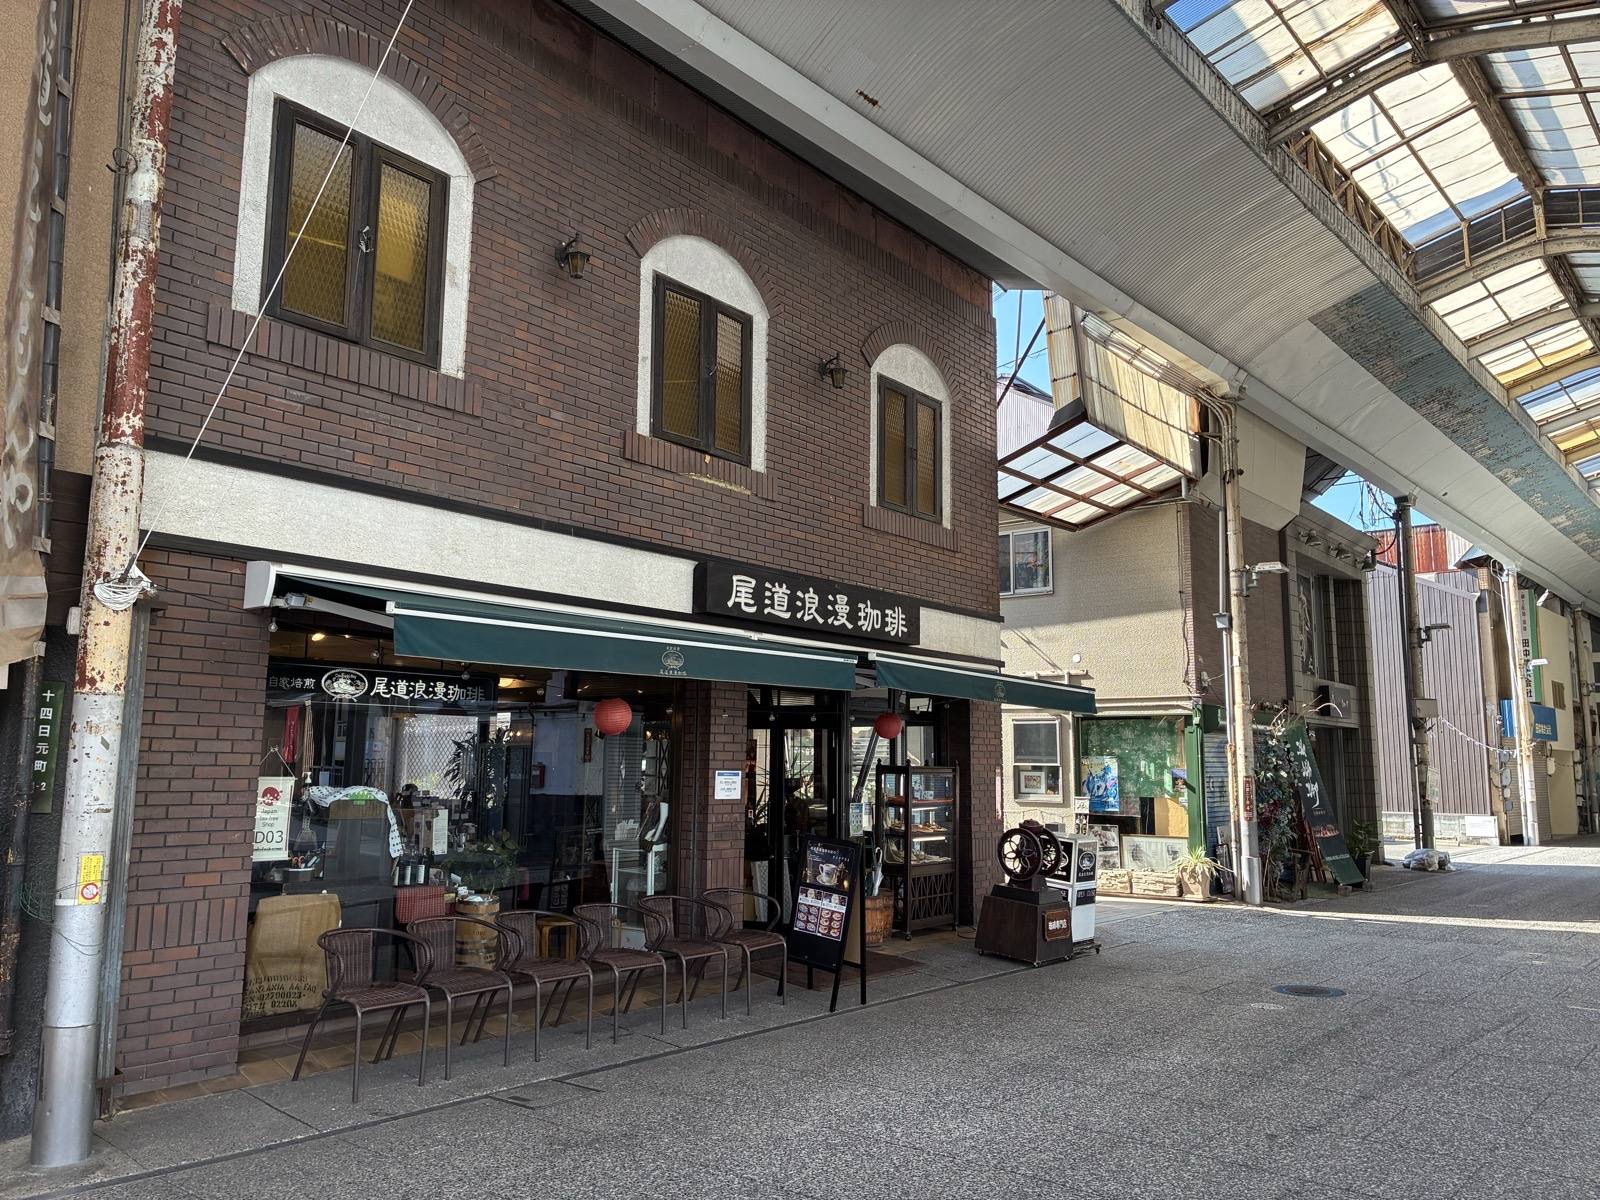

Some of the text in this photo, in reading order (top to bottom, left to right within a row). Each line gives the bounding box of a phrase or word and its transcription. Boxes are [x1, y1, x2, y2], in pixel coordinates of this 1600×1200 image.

[727, 574, 908, 637] 尾道浪漫珈琲
[268, 676, 316, 690] 自家焙煎
[370, 677, 485, 702] 尾道浪漫珈琲
[34, 689, 55, 772] 十四日元町
[255, 830, 284, 844] D03
